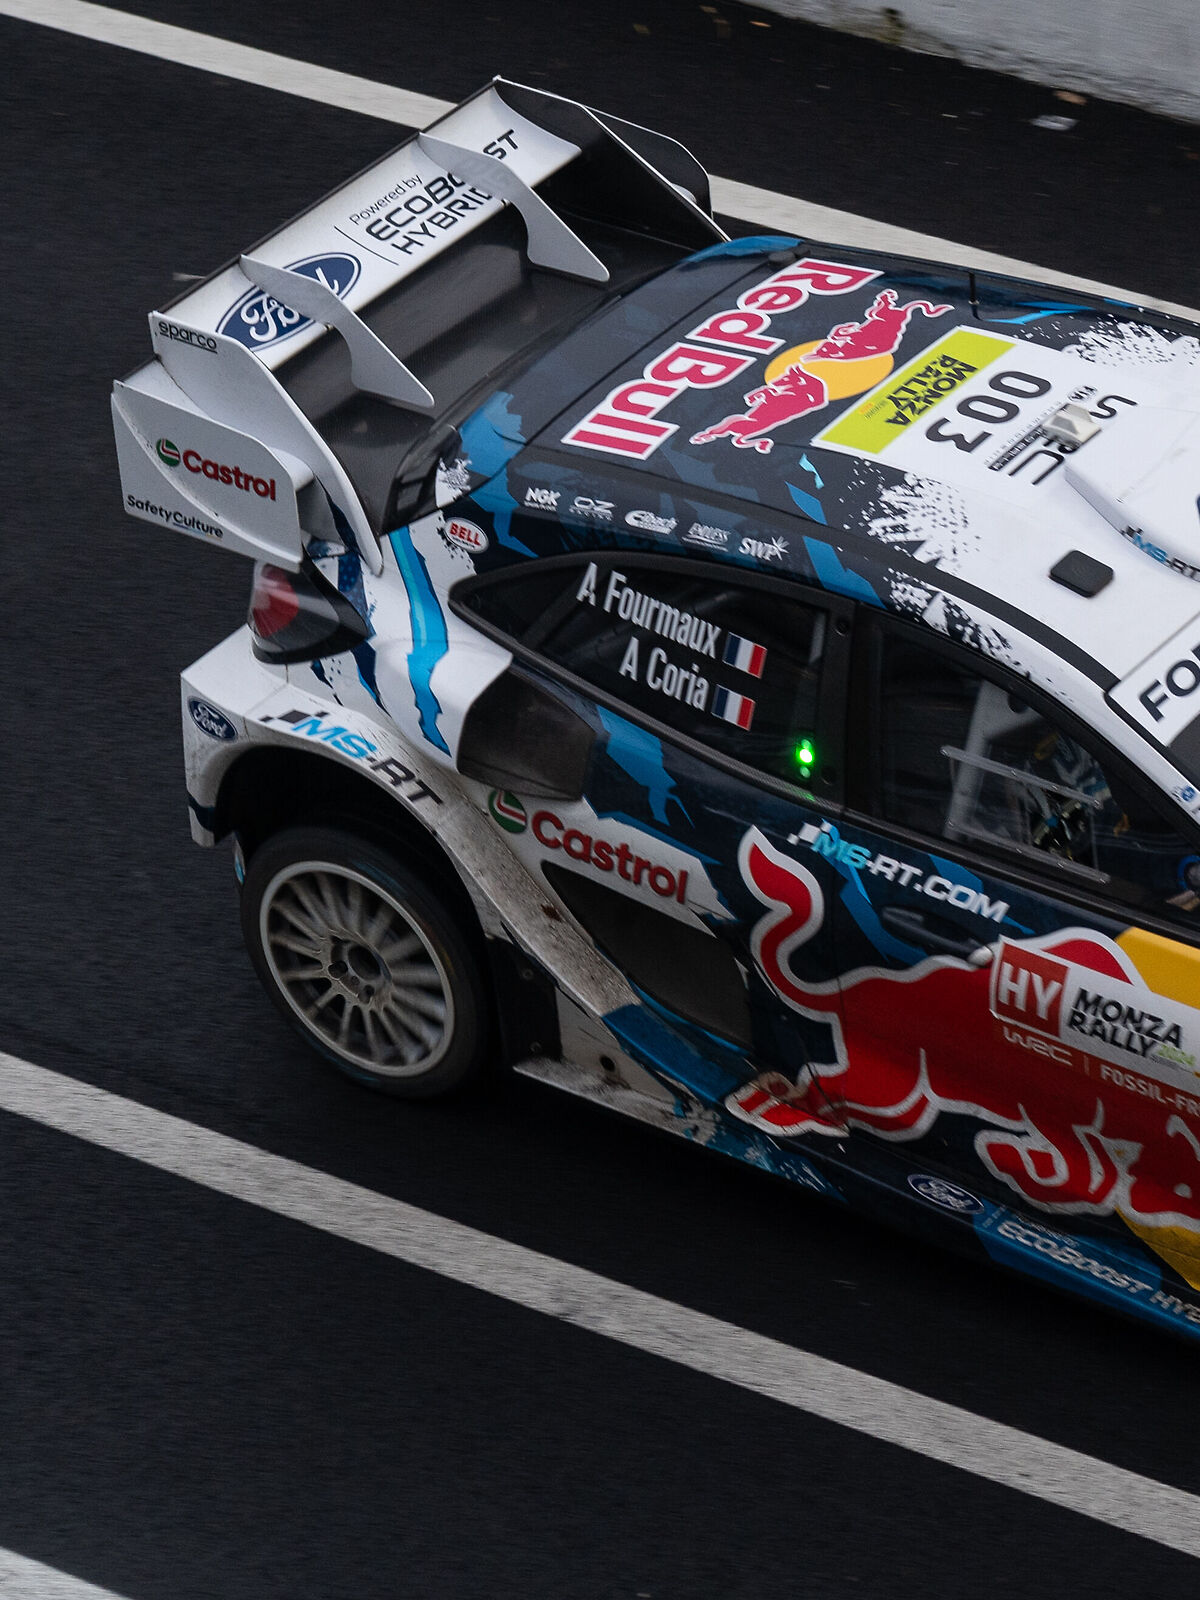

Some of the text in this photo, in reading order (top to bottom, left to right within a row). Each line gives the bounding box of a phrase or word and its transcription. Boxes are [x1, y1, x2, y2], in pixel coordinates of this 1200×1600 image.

[349, 174, 425, 225] Powered by
[366, 129, 520, 244] ECOBST
[158, 320, 218, 353] sparco
[886, 361, 979, 427] MONZA
[925, 371, 1053, 453] 003
[182, 449, 277, 502] Castrol
[525, 487, 561, 506] NGK
[127, 494, 225, 540] SafetyCulture
[449, 522, 483, 546] BELL
[576, 562, 722, 659] A Fourmaux
[618, 637, 709, 711] A Coria
[531, 809, 688, 904] Castrol
[999, 961, 1062, 1021] HY
[1071, 987, 1184, 1049] MONZA
[1067, 1008, 1157, 1058] RALLY
[996, 1220, 1153, 1294] ECOBOOST
